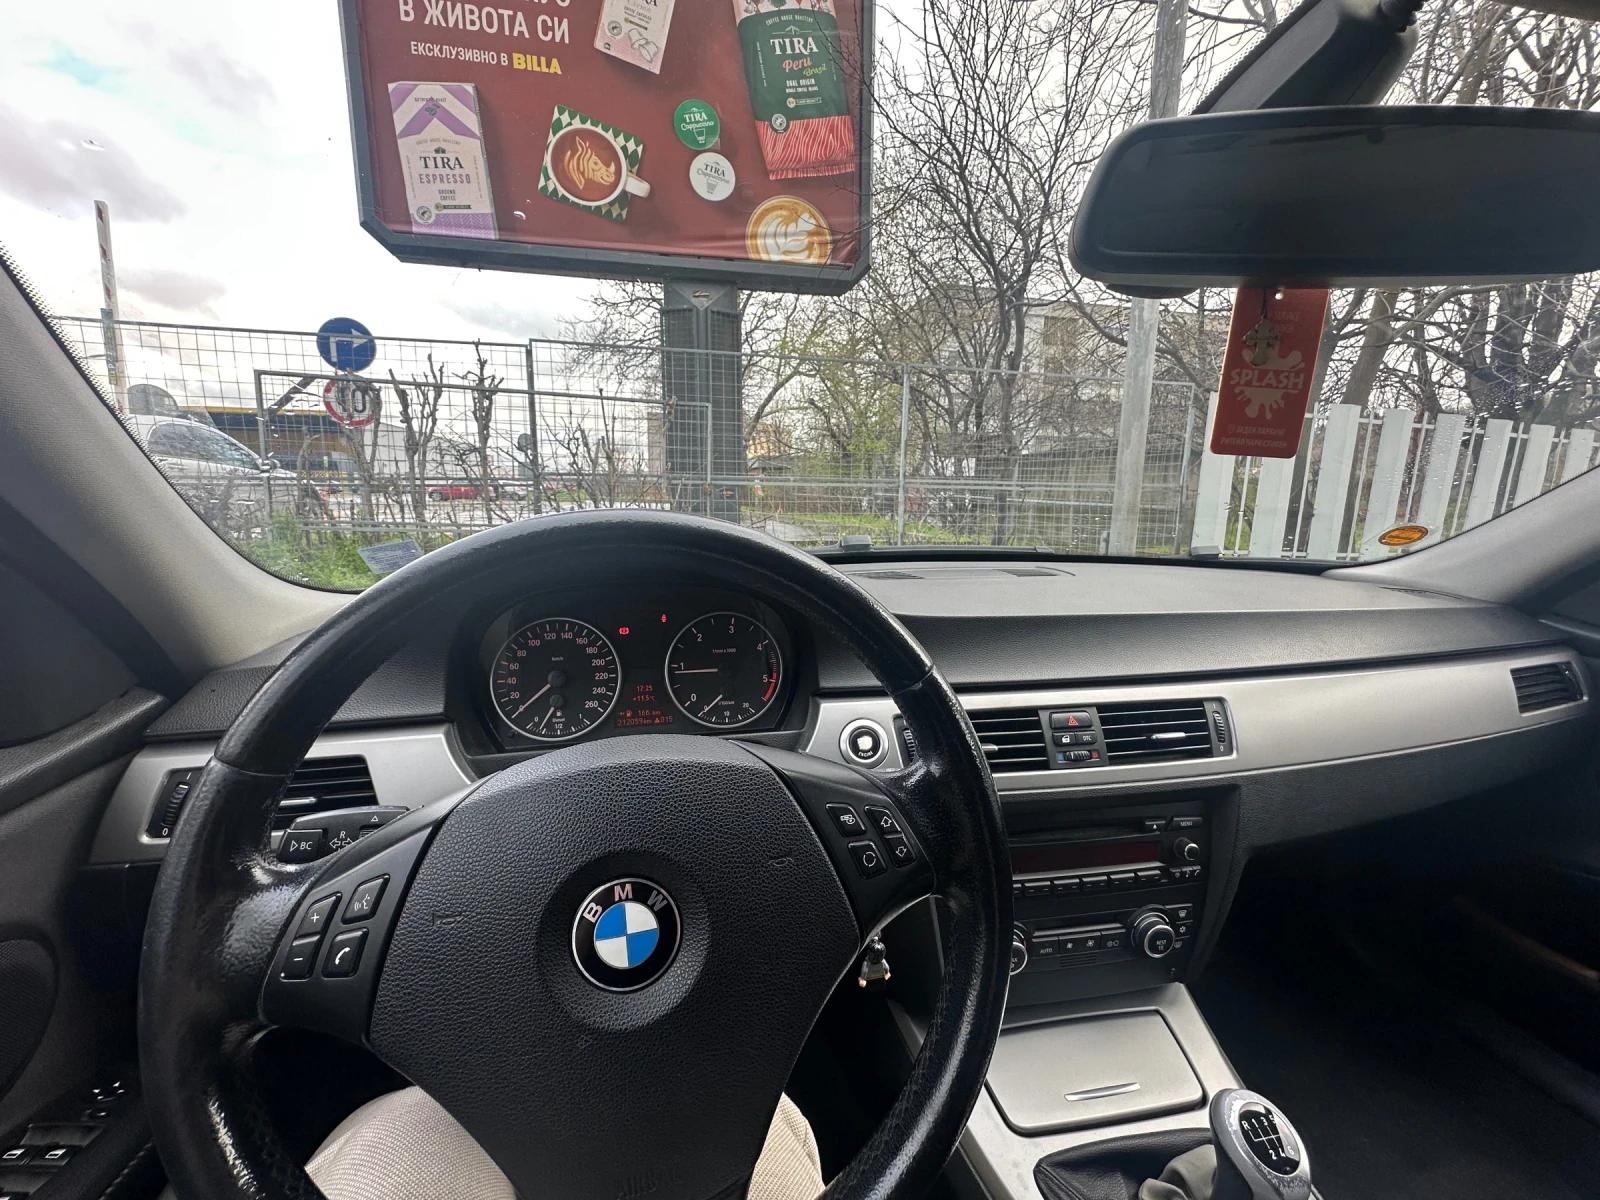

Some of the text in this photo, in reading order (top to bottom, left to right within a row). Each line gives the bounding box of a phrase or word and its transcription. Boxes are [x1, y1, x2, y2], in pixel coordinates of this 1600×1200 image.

[399, 0, 570, 44] В ЖИВОТА СИ
[769, 36, 819, 55] TIRA
[410, 41, 562, 75] ЕКСКЛУЗИВНО В BILLA
[782, 57, 813, 73] Peru
[803, 63, 828, 77] Brazil
[800, 78, 815, 86] ORIGIN
[684, 112, 708, 123] TIRA
[681, 121, 715, 131] Cappuccino
[420, 156, 465, 170] TIRA
[697, 168, 731, 184] Cappuccino
[704, 163, 726, 178] TIRA
[419, 173, 472, 185] ESPRESSO
[1230, 368, 1304, 388] SPLASH
[728, 625, 734, 634] 3
[528, 639, 540, 647] 100
[576, 637, 588, 645] 160
[697, 634, 703, 642] 2
[586, 646, 598, 654] 180
[756, 643, 762, 651] 4
[680, 662, 684, 670] 1
[690, 693, 697, 702] 0
[339, 831, 346, 839] R
[300, 841, 313, 850] BC
[582, 883, 668, 923] BMW
[1241, 1120, 1251, 1131] R
[1251, 1118, 1259, 1128] 1
[1260, 1116, 1268, 1126] 3
[1269, 1149, 1277, 1160] 2
